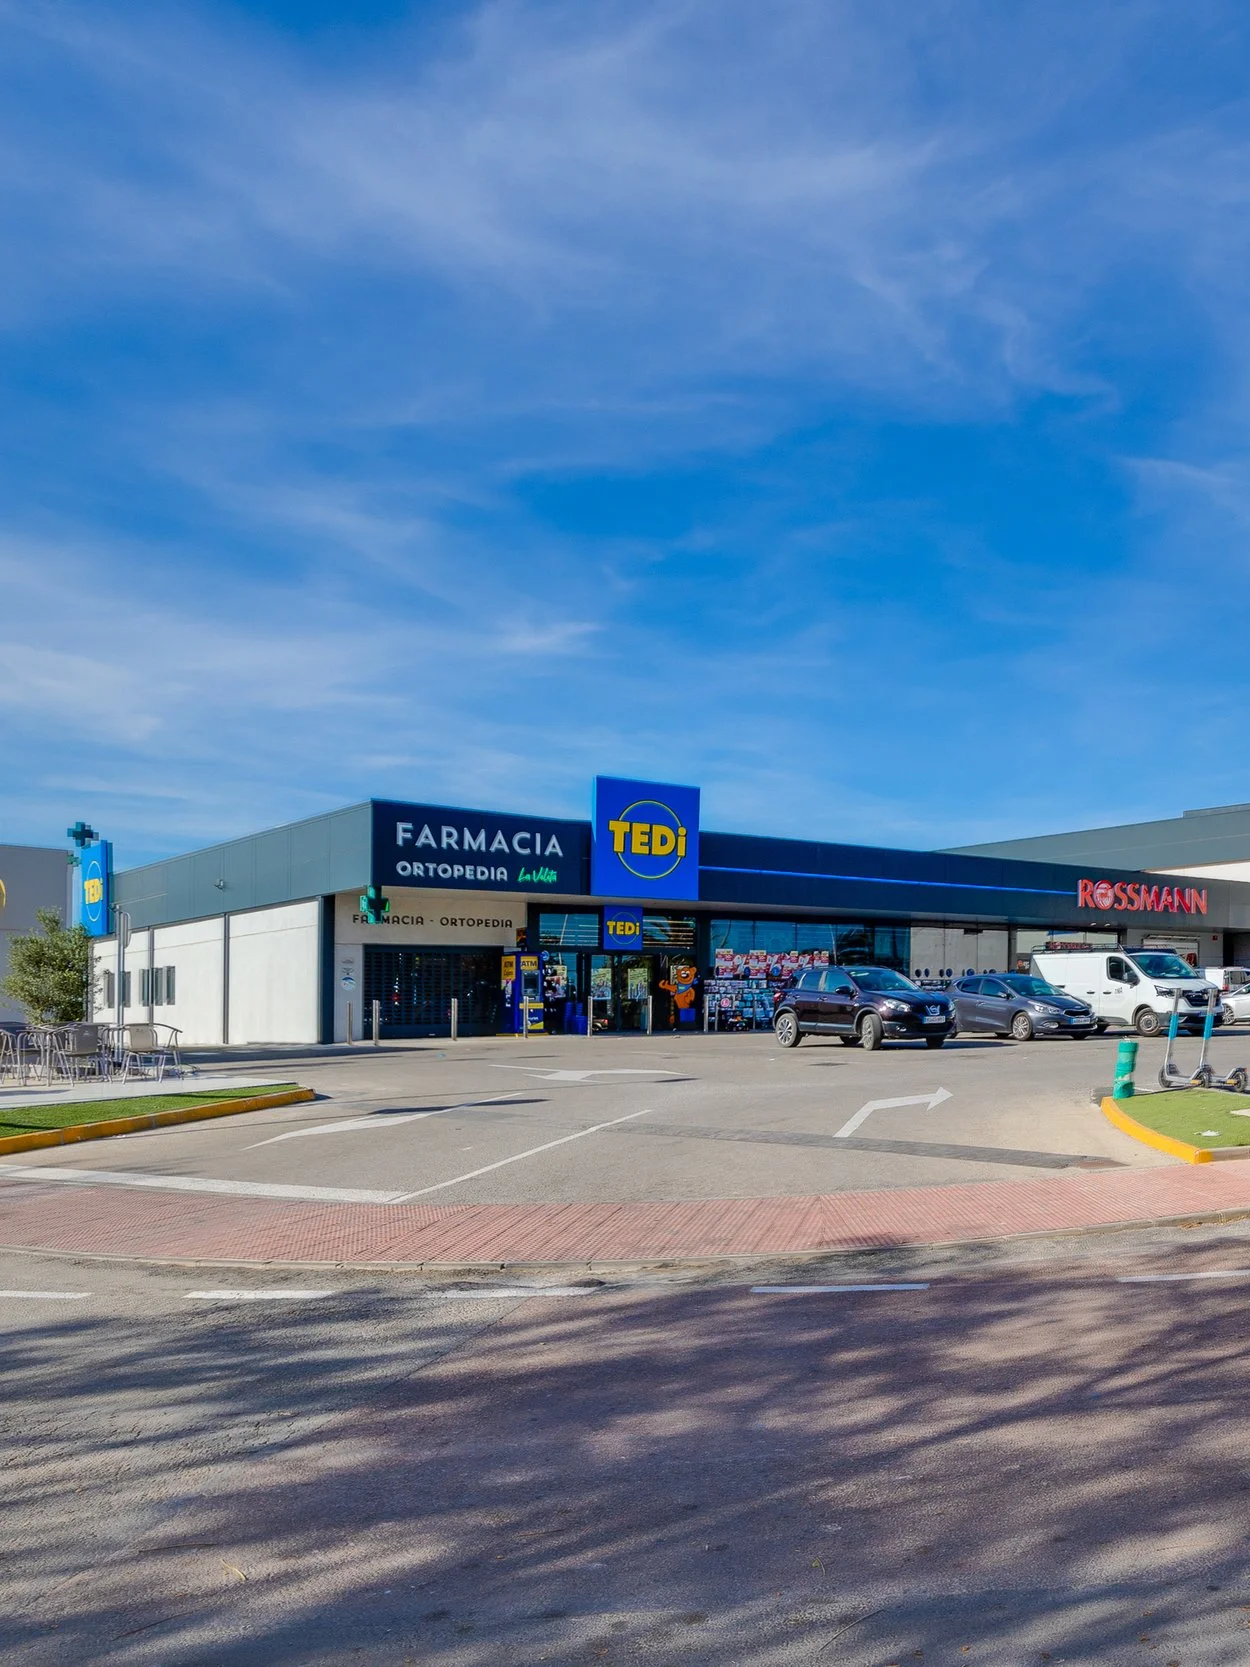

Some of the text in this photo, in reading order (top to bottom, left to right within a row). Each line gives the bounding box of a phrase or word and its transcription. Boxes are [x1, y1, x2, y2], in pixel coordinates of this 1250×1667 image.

[395, 821, 564, 858] FARMACIA
[608, 819, 687, 857] TEDi
[395, 860, 508, 882] ORTOPEDIA
[517, 867, 531, 883] La
[1077, 879, 1208, 915] ROSSMANN
[352, 914, 424, 926] FAMACIA
[439, 916, 513, 928] ORTOPEDIA
[606, 921, 640, 936] TEDi
